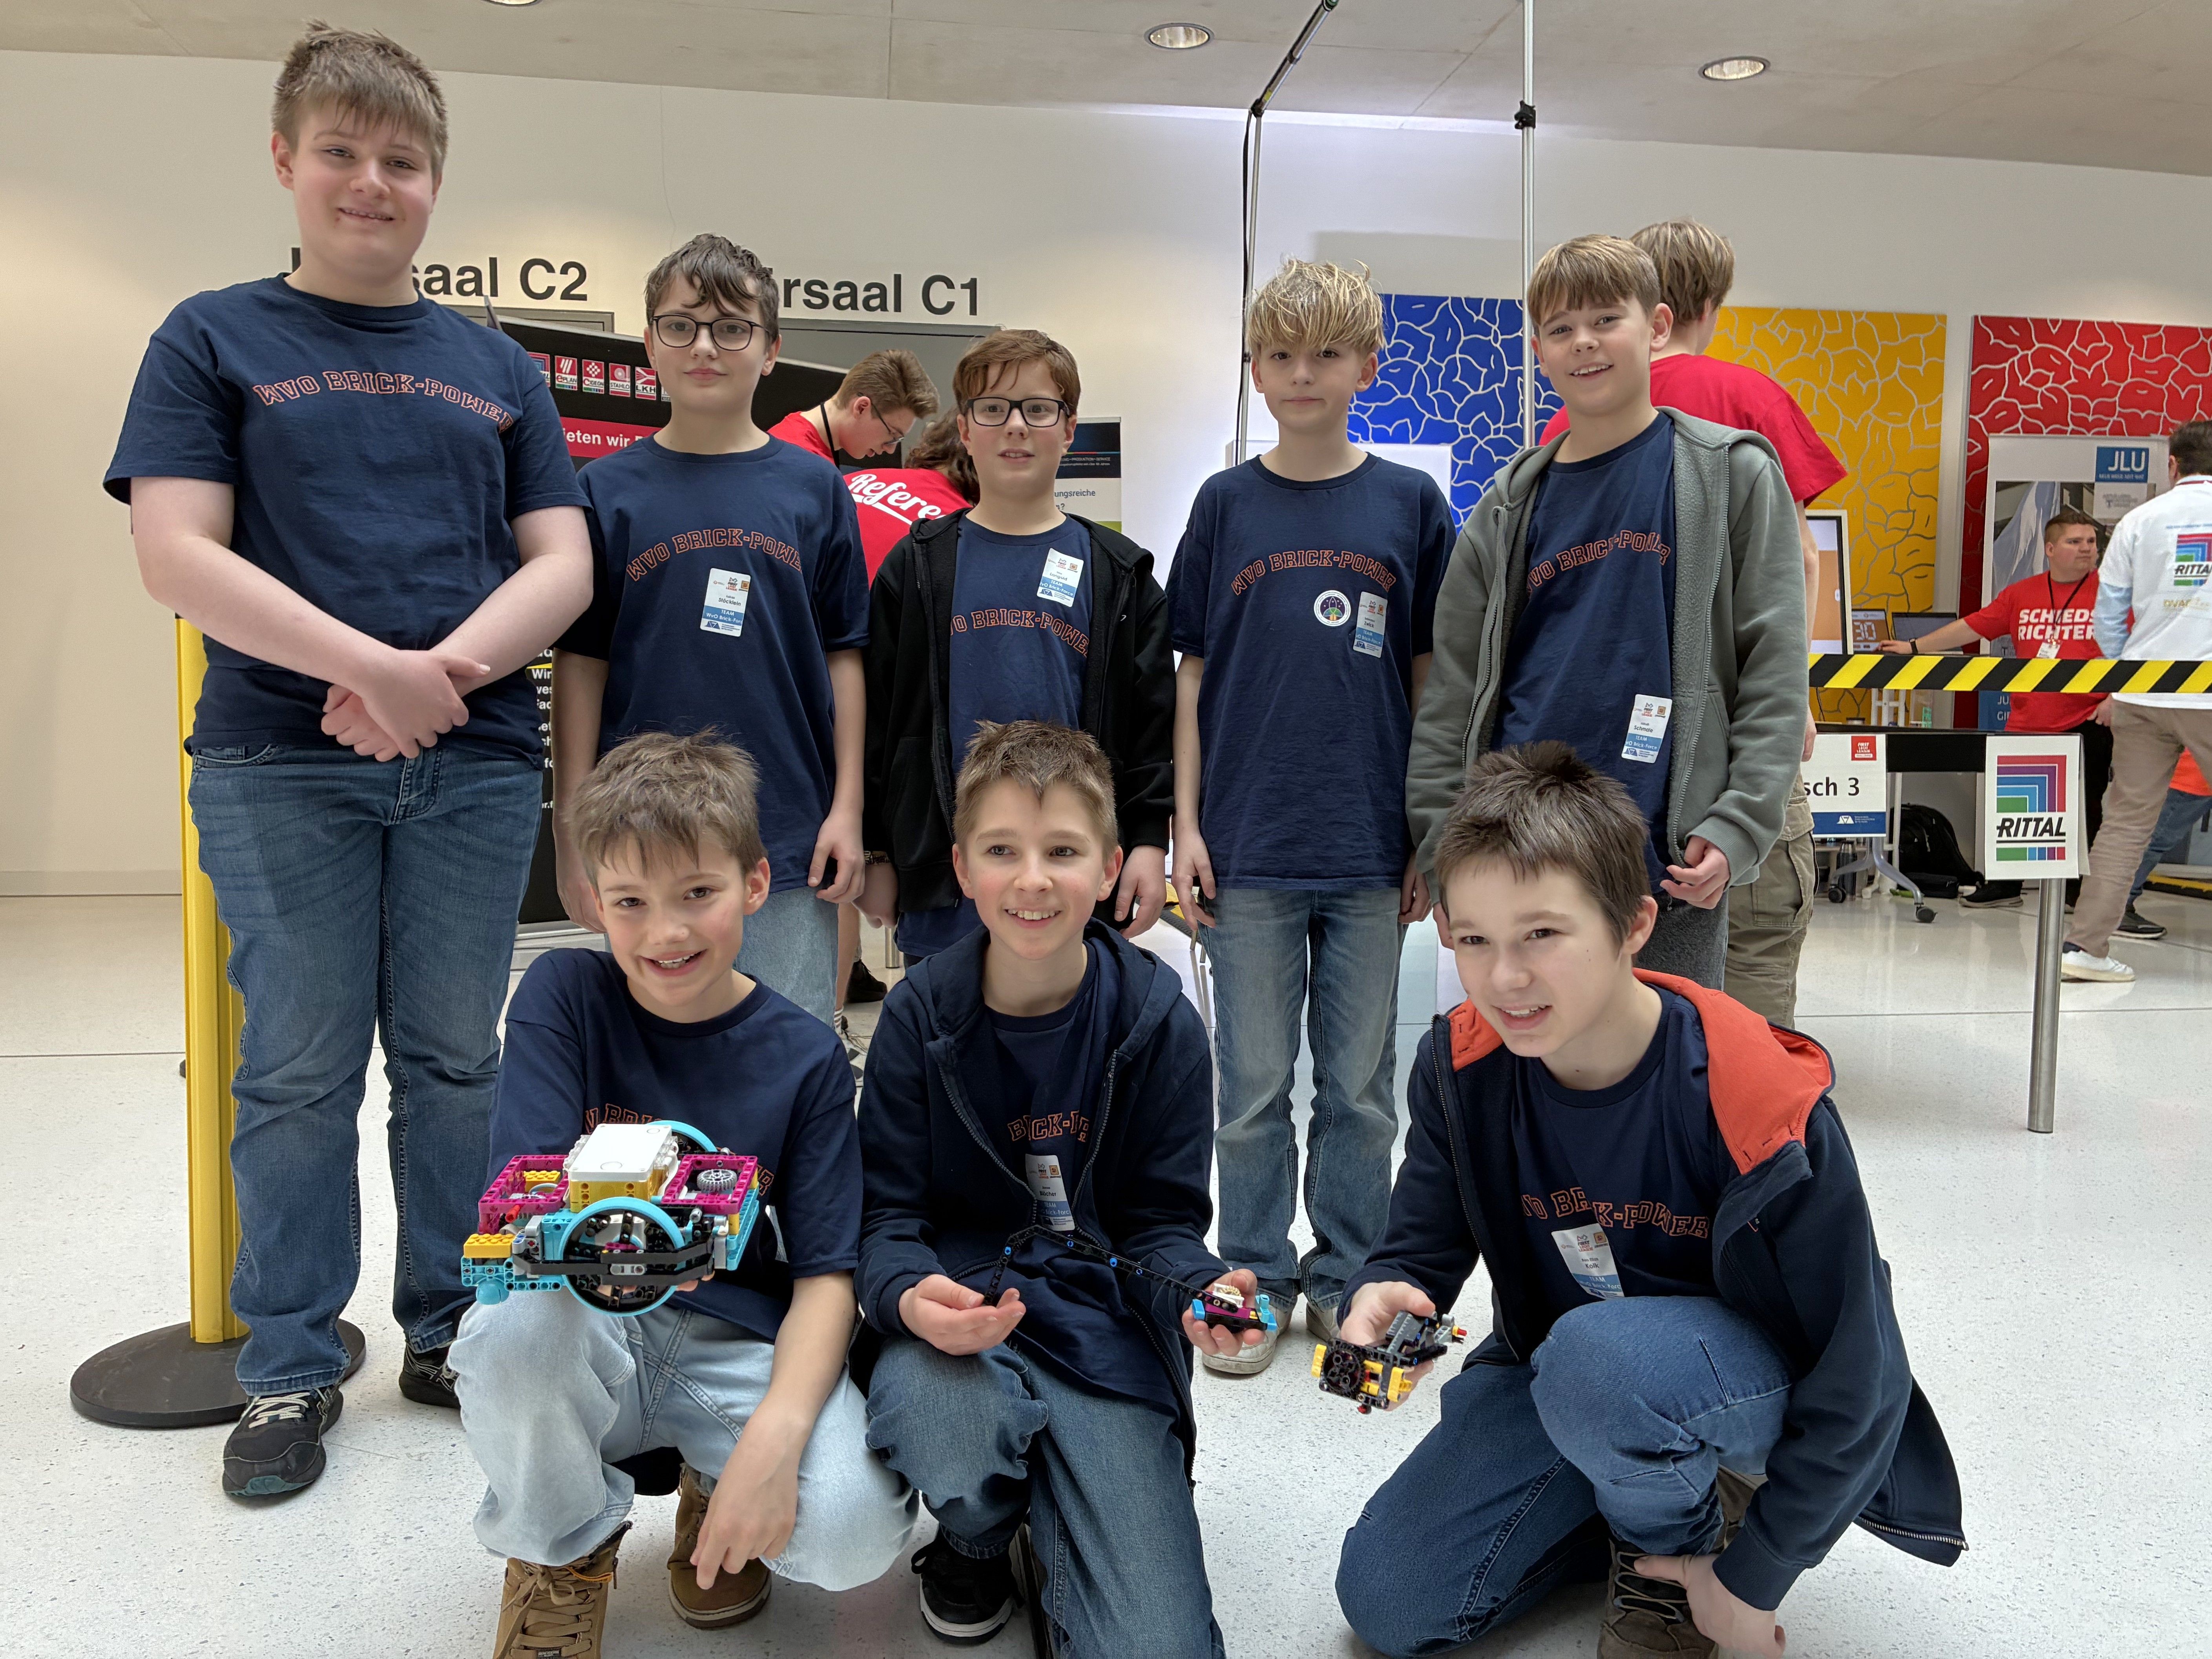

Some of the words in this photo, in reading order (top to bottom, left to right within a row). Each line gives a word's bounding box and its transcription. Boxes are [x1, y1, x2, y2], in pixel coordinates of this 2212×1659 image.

[520, 258, 587, 301] C2
[784, 274, 901, 312] rsaal
[922, 275, 977, 315] C1
[253, 376, 320, 405] WVO
[606, 434, 630, 447] wir
[2108, 451, 2145, 472] JLU
[848, 474, 947, 520] Refere
[626, 542, 670, 581] WVO
[672, 528, 802, 572] BRICK-POWE
[2175, 564, 2212, 574] RITTA
[1231, 560, 1265, 595] WVO
[1269, 550, 1396, 592] BRICK-POWER
[1527, 560, 1555, 593] VO
[971, 609, 1089, 657] BRICK-POWE
[1853, 622, 1876, 641] 30
[1804, 777, 1837, 796] sch
[1848, 777, 1860, 796] 3
[1997, 816, 2066, 838] RITTAL
